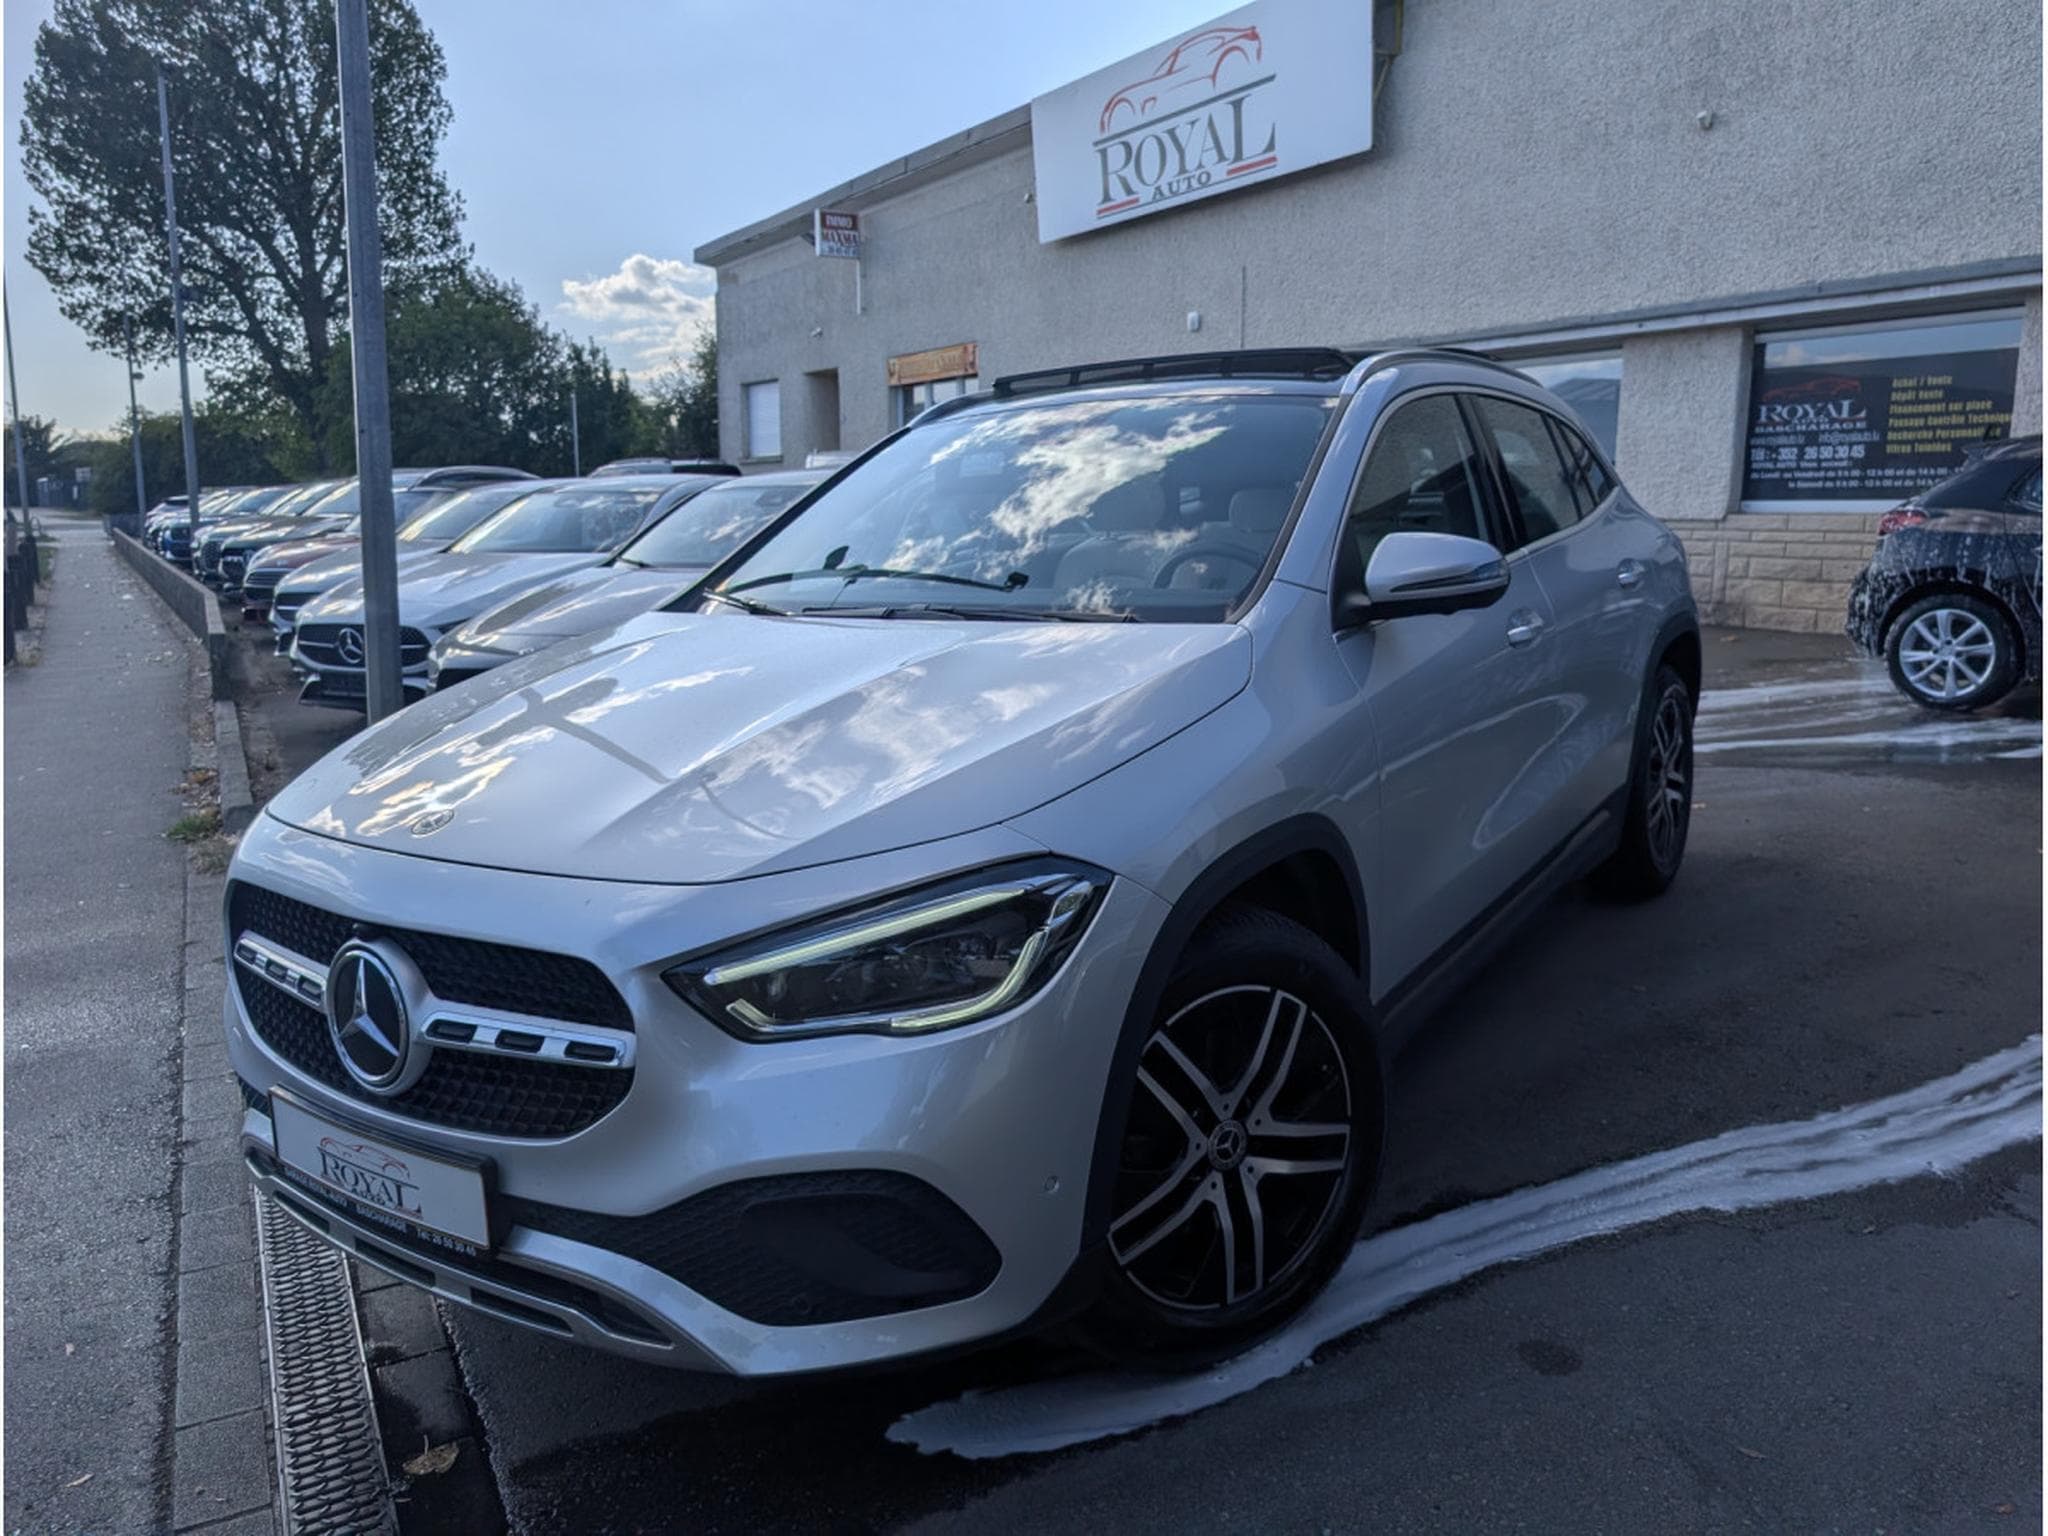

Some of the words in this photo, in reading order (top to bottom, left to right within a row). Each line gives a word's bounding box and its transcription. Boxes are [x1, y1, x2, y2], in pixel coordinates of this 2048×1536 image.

[1096, 94, 1276, 205] ROYAL
[1151, 171, 1212, 200] AUTO
[1759, 399, 1867, 422] ROYAL
[1889, 402, 1946, 414] Financement
[1755, 421, 1867, 434] BASCHARAGE
[320, 1151, 422, 1213] ROYAL
